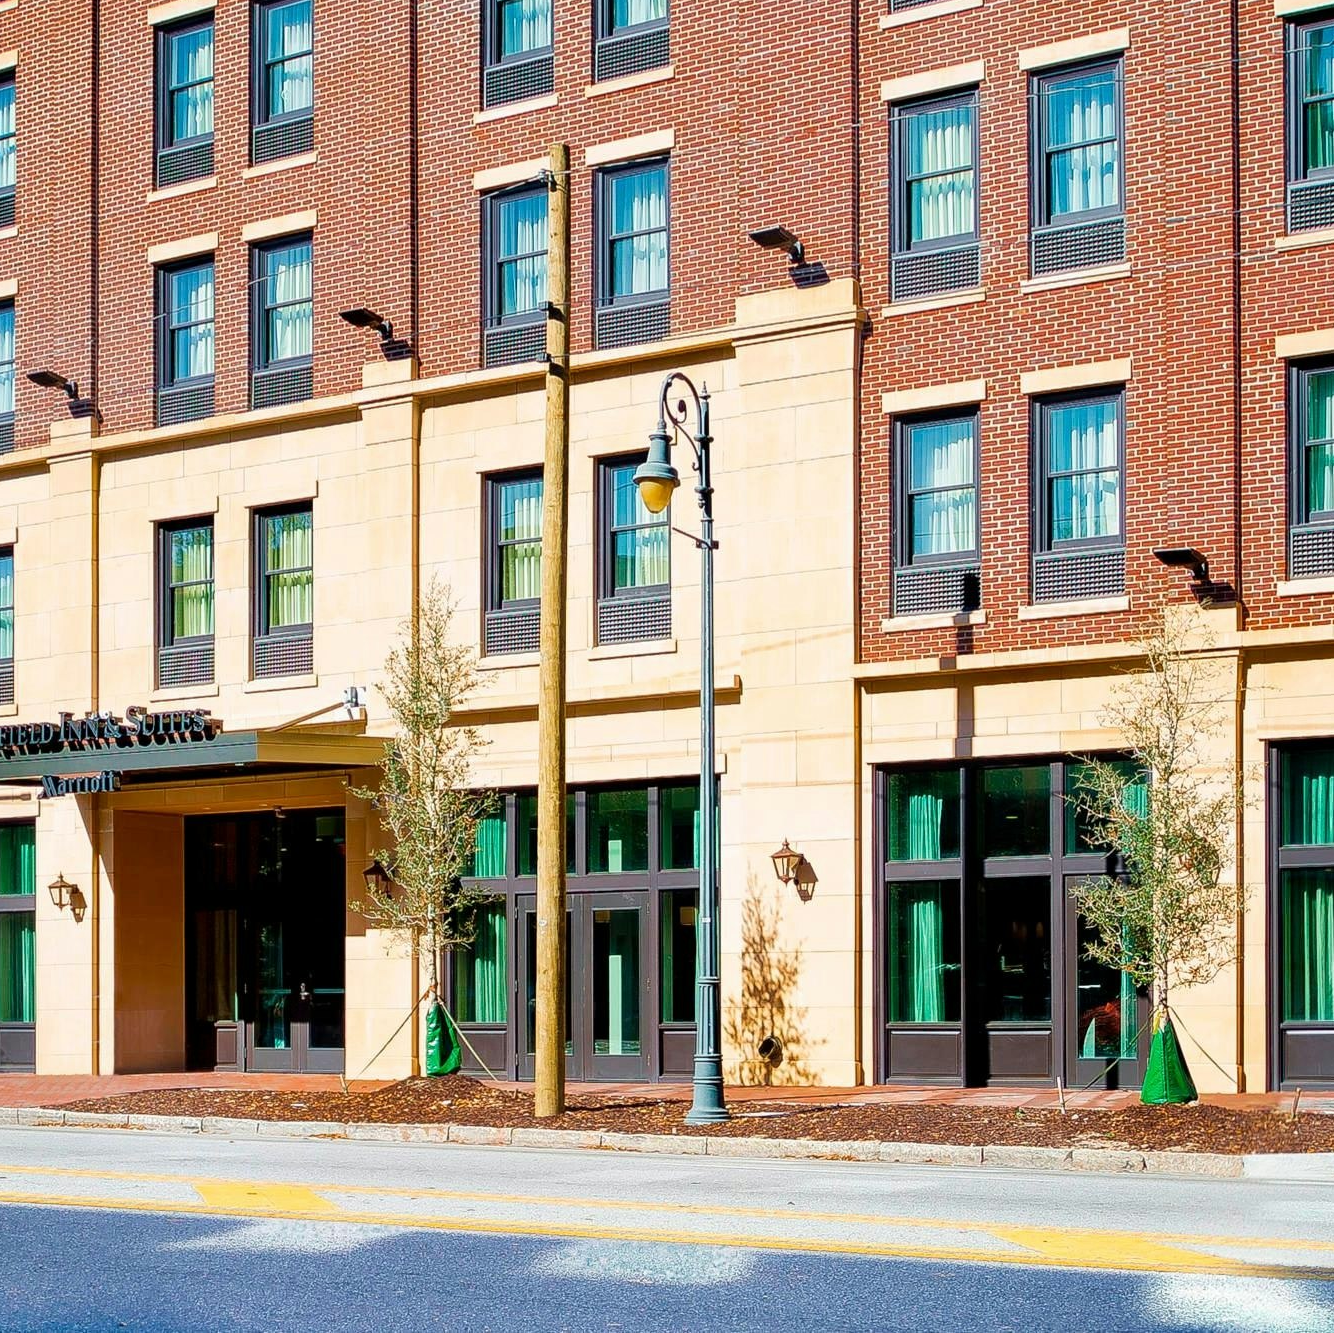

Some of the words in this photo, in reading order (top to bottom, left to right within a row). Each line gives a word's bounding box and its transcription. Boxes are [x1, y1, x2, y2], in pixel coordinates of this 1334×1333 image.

[58, 711, 100, 742] INN
[103, 712, 123, 739] &
[125, 705, 207, 737] SUITES
[39, 770, 118, 799] Marriott
